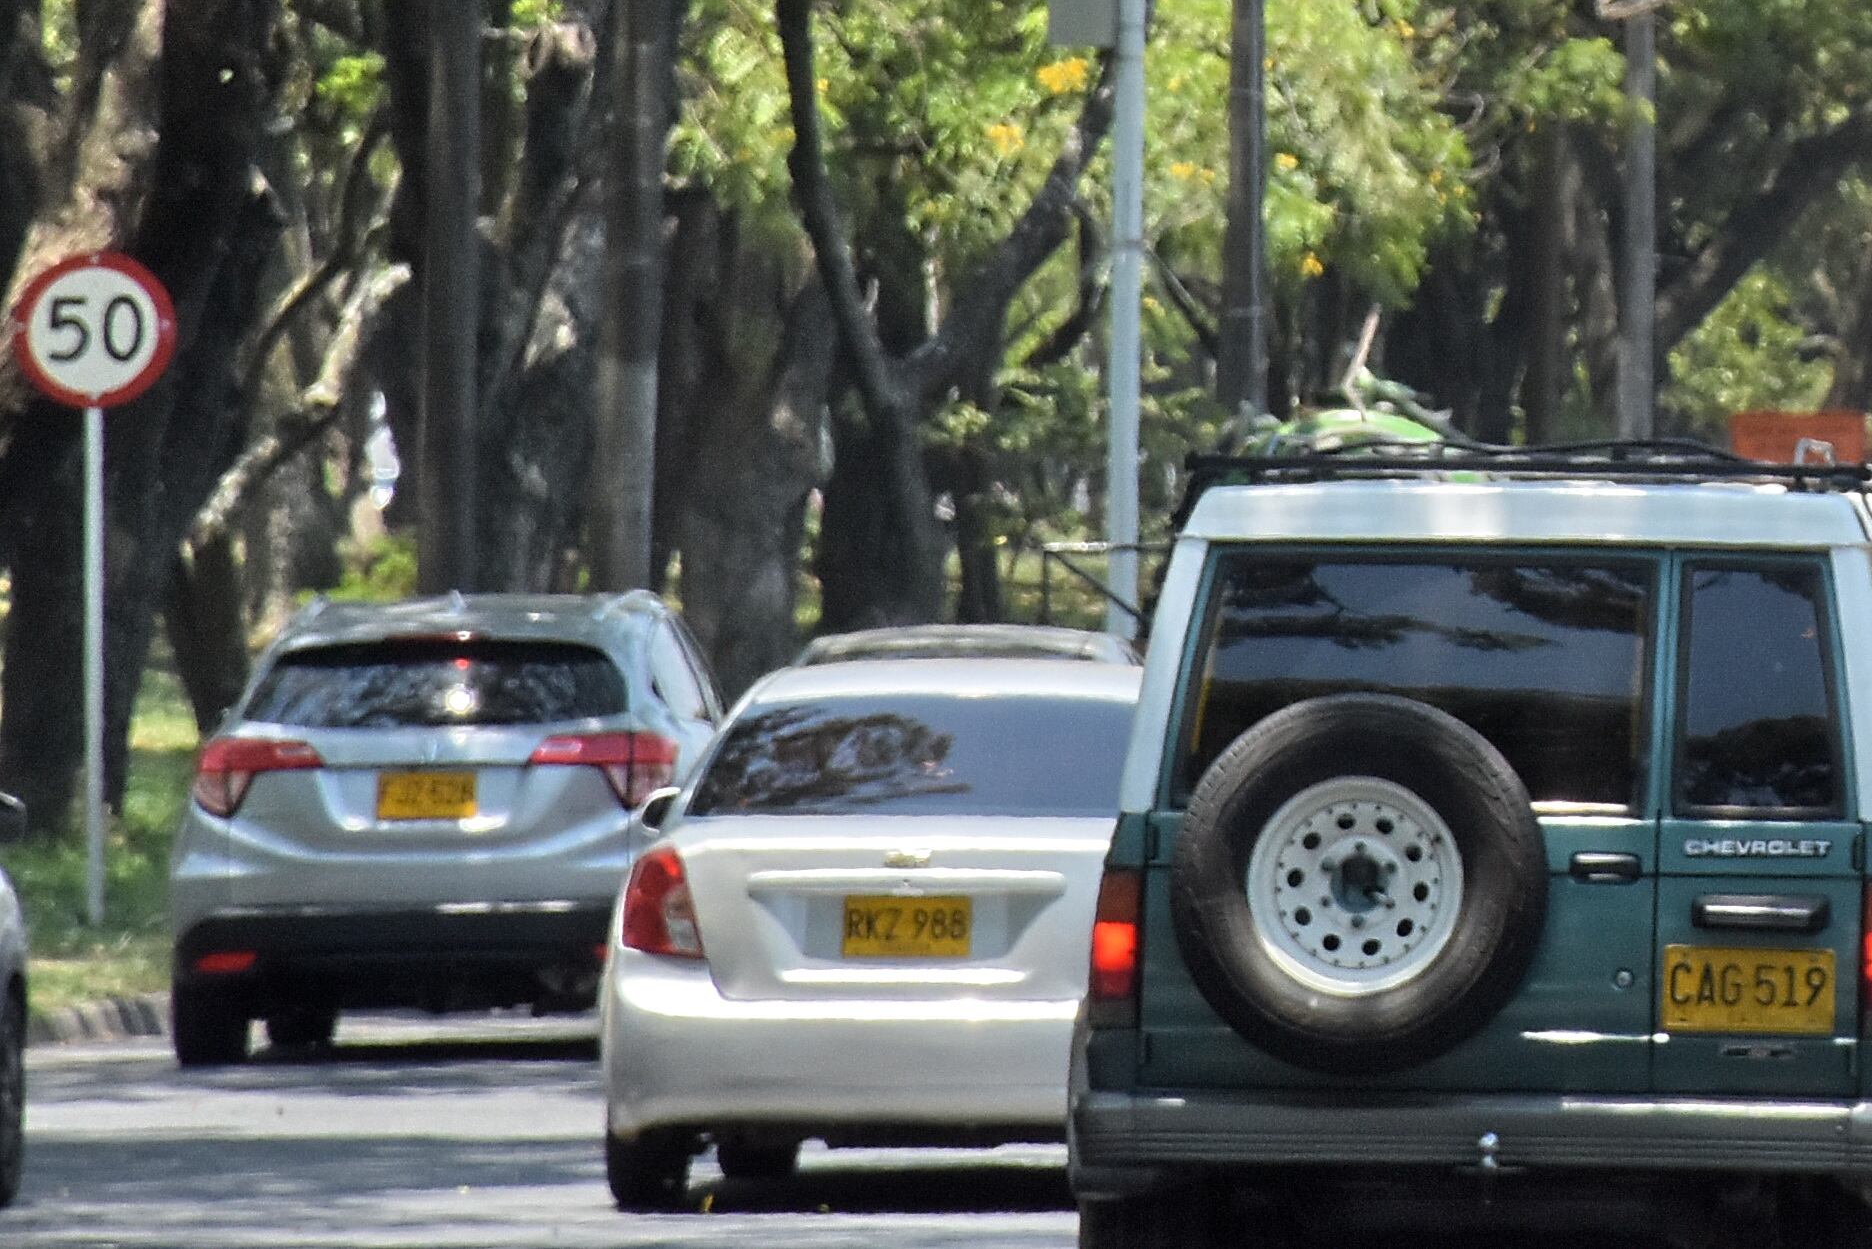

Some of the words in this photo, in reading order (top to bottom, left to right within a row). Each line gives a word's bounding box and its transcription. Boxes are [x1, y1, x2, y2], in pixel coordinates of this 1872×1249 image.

[50, 296, 143, 362] 50
[1684, 839, 1833, 857] CHEVROLET
[847, 907, 901, 941] RKZ
[913, 907, 967, 941] 988
[1669, 961, 1743, 1007] CAG
[1754, 963, 1827, 1008] 519
